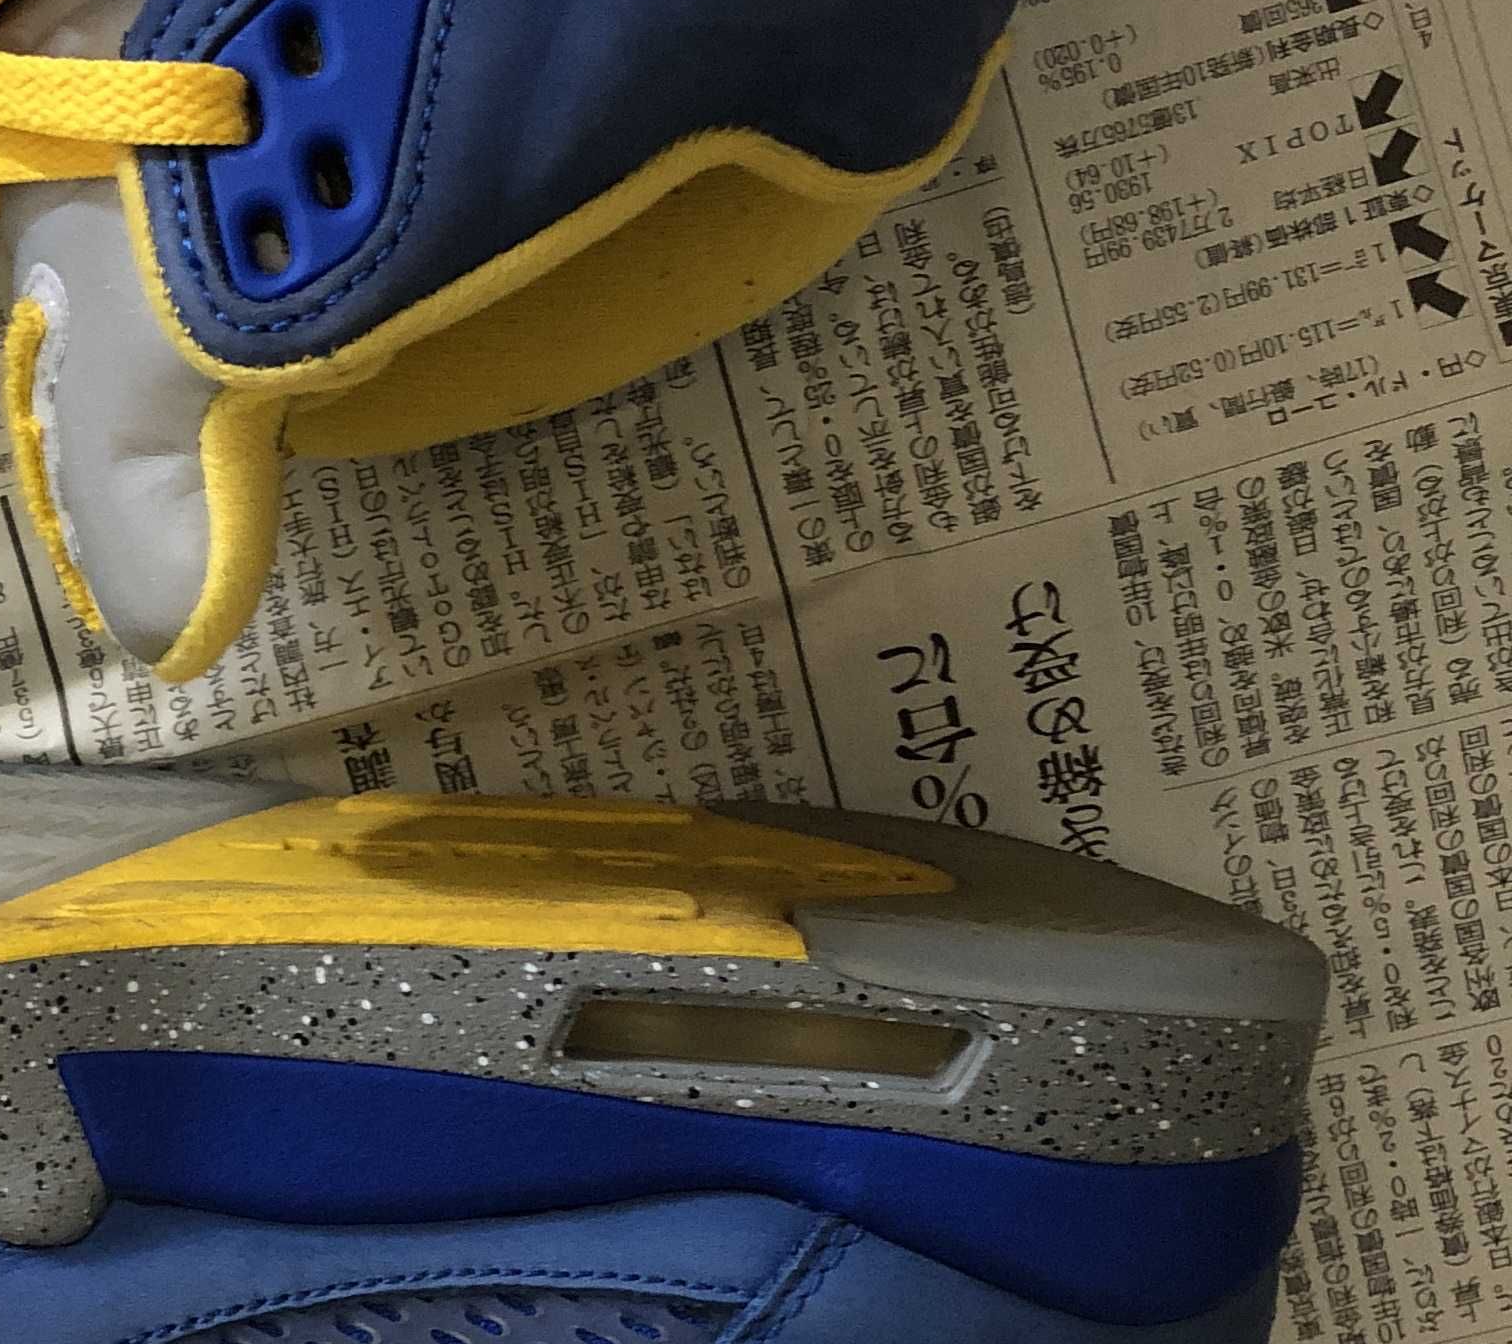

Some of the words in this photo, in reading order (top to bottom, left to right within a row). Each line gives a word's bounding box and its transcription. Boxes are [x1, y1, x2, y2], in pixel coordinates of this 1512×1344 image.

[1266, 55, 1342, 97] 出来高
[1232, 111, 1354, 165] TOPIX
[1067, 169, 1153, 212] 1930.56
[1270, 164, 1369, 212] 日経平均
[680, 429, 754, 592] の判断という。
[329, 718, 397, 796] 調査
